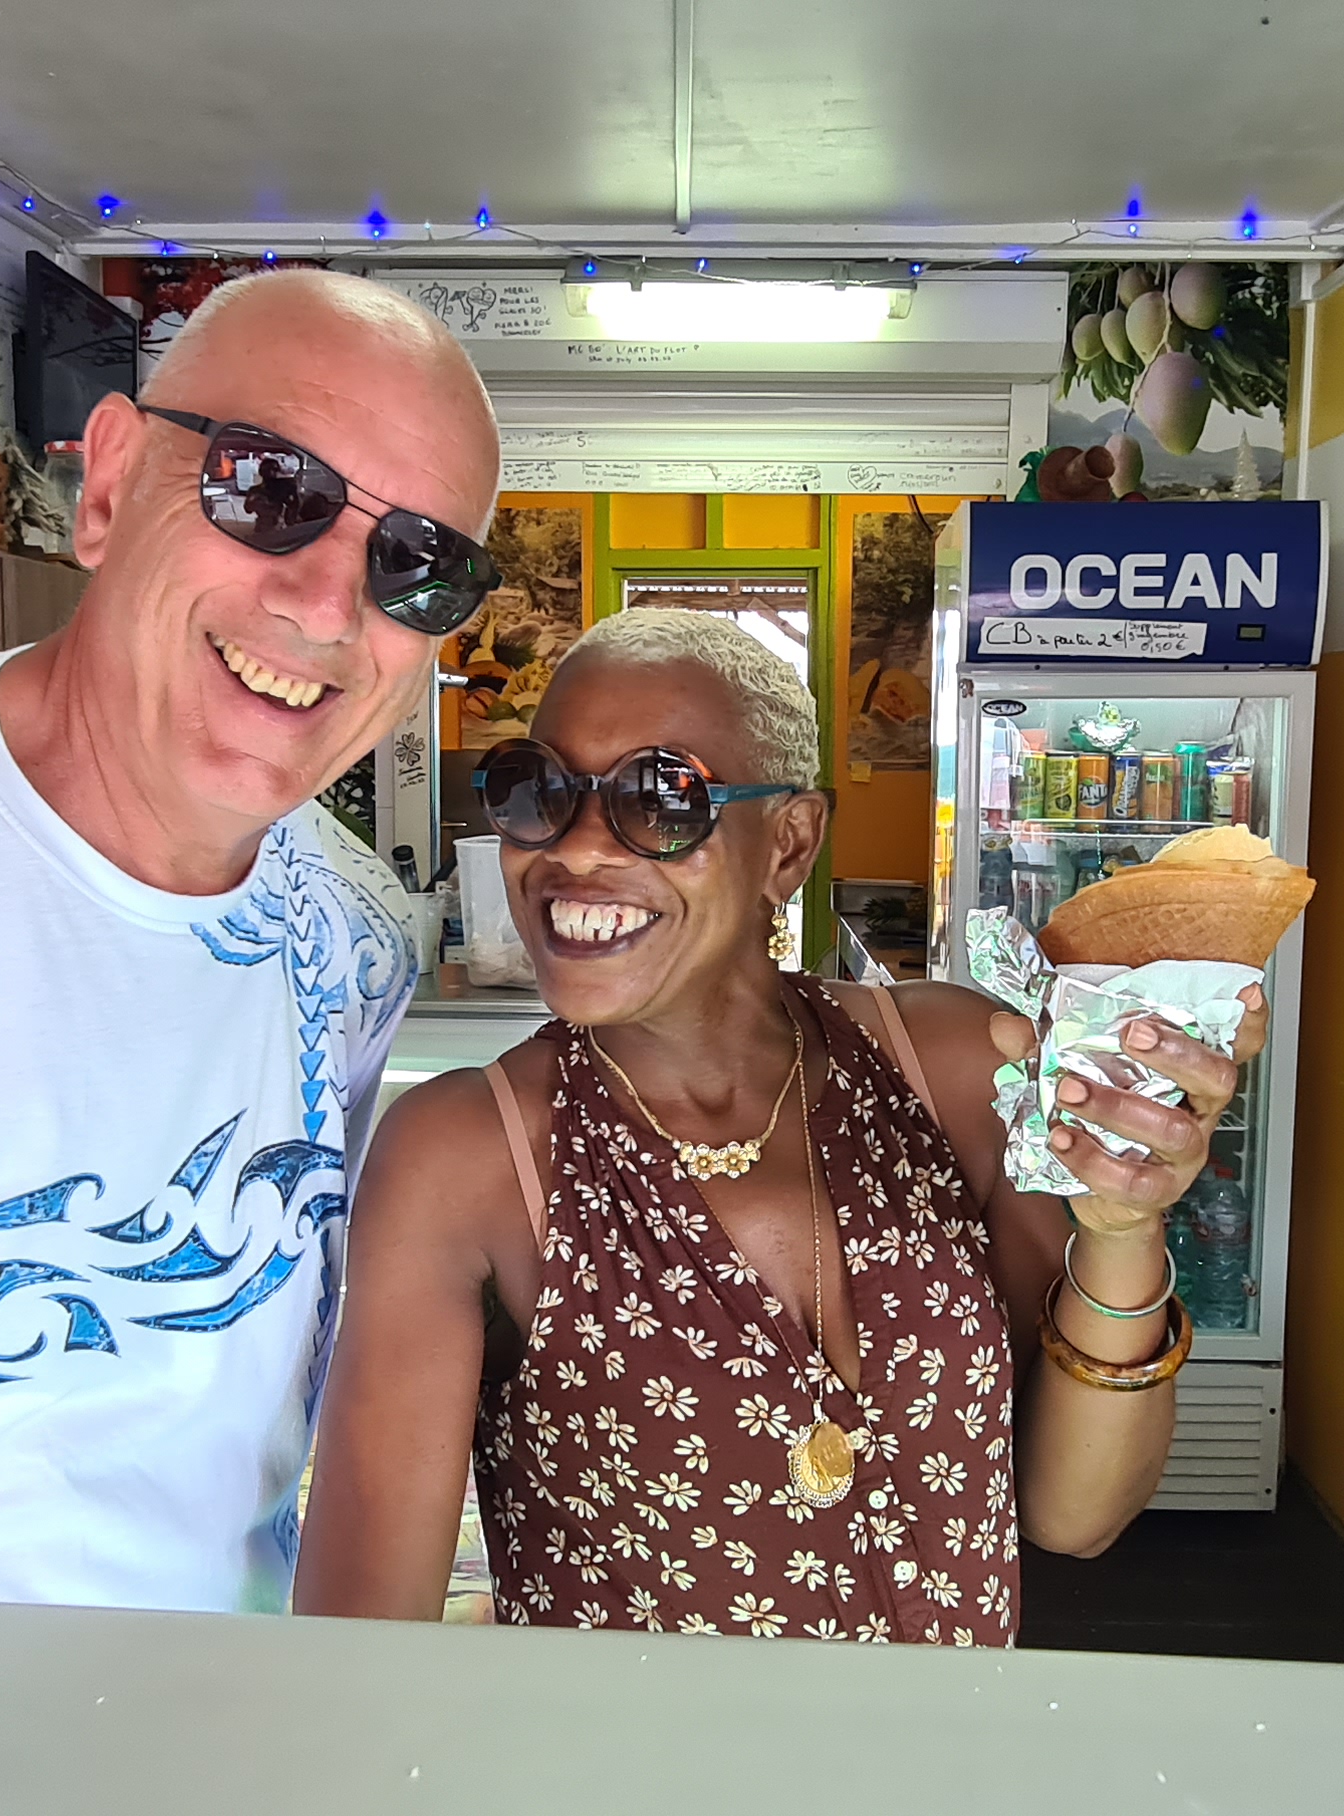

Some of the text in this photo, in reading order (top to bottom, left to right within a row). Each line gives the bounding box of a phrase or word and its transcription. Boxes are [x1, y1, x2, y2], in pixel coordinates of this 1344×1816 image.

[1010, 552, 1279, 610] OCEAN
[986, 621, 1032, 645] CB
[984, 703, 1024, 714] OCEAN
